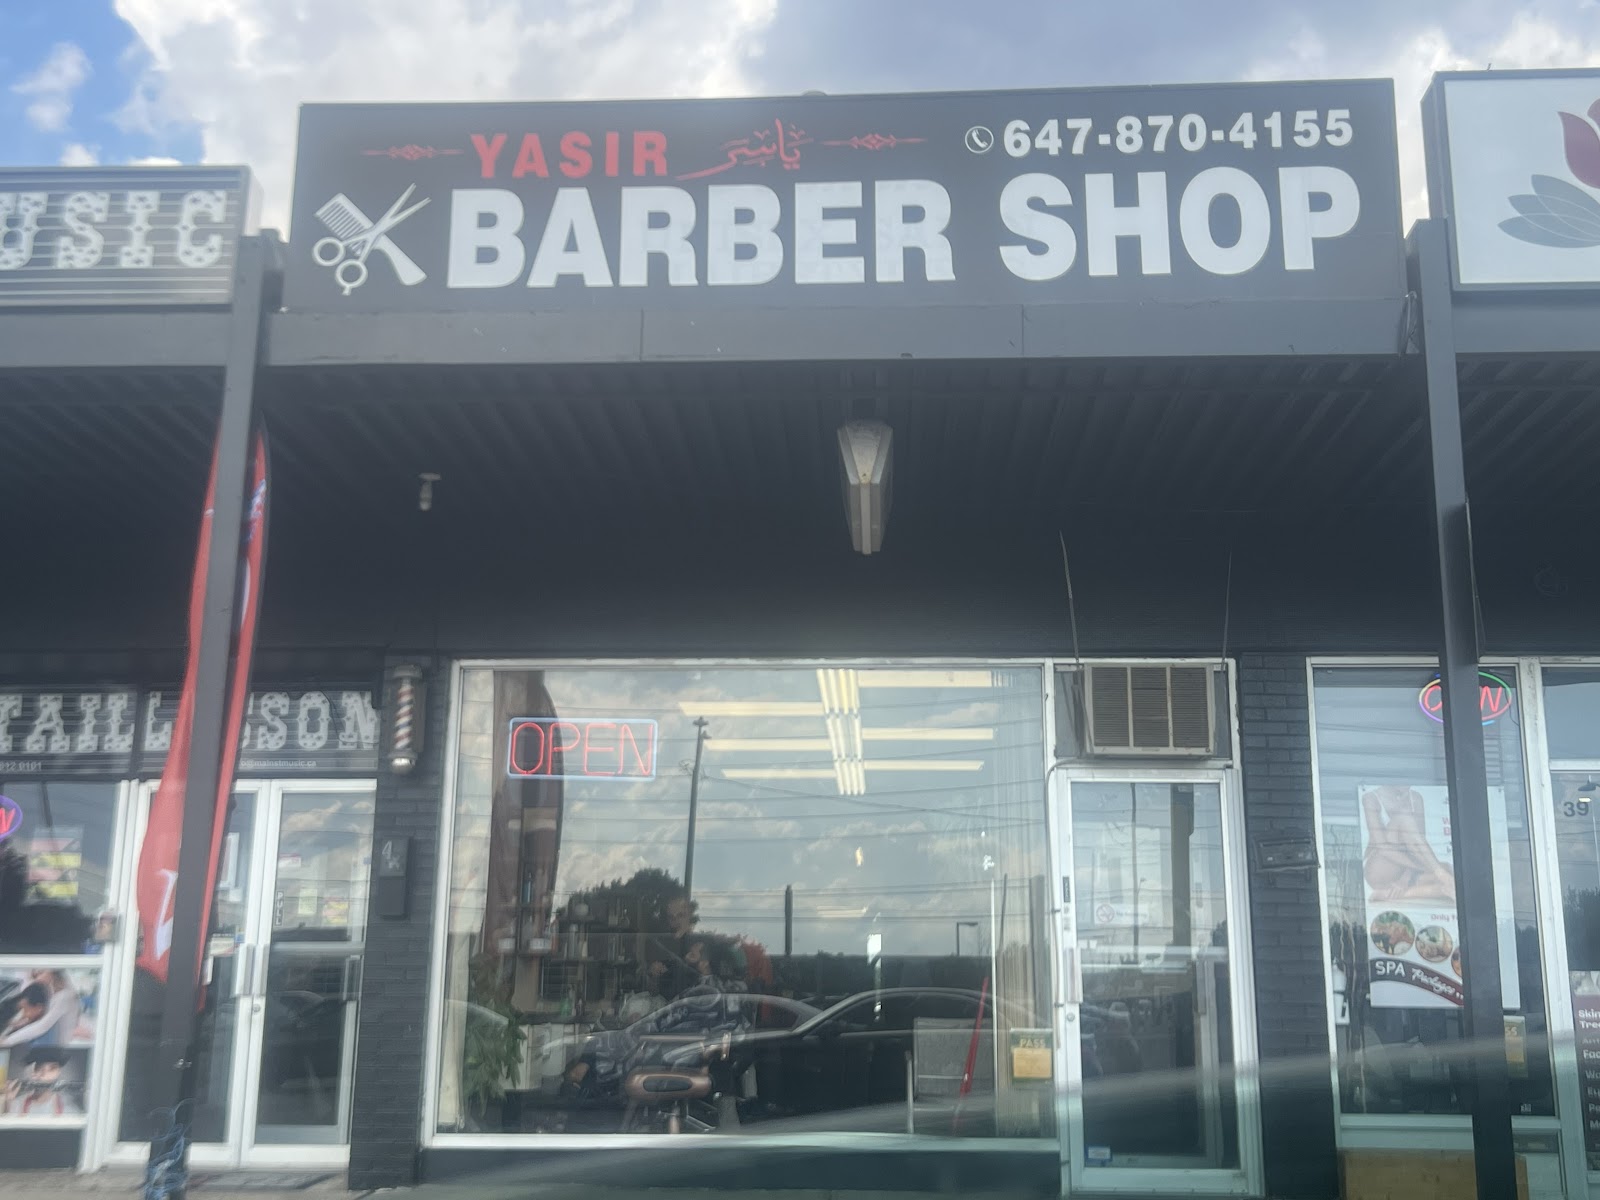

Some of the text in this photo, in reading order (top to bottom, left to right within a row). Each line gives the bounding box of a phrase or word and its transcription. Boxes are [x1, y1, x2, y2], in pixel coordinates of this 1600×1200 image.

[1003, 109, 1353, 157] 647-870-4155
[470, 130, 668, 179] YASIR
[447, 166, 1361, 288] BARBER SHOP
[1424, 685, 1503, 712] ON
[512, 722, 654, 776] OPEN
[1563, 801, 1589, 817] 39
[276, 891, 284, 926] PULL
[1375, 961, 1406, 978] SPA
[1020, 1038, 1046, 1049] PASS
